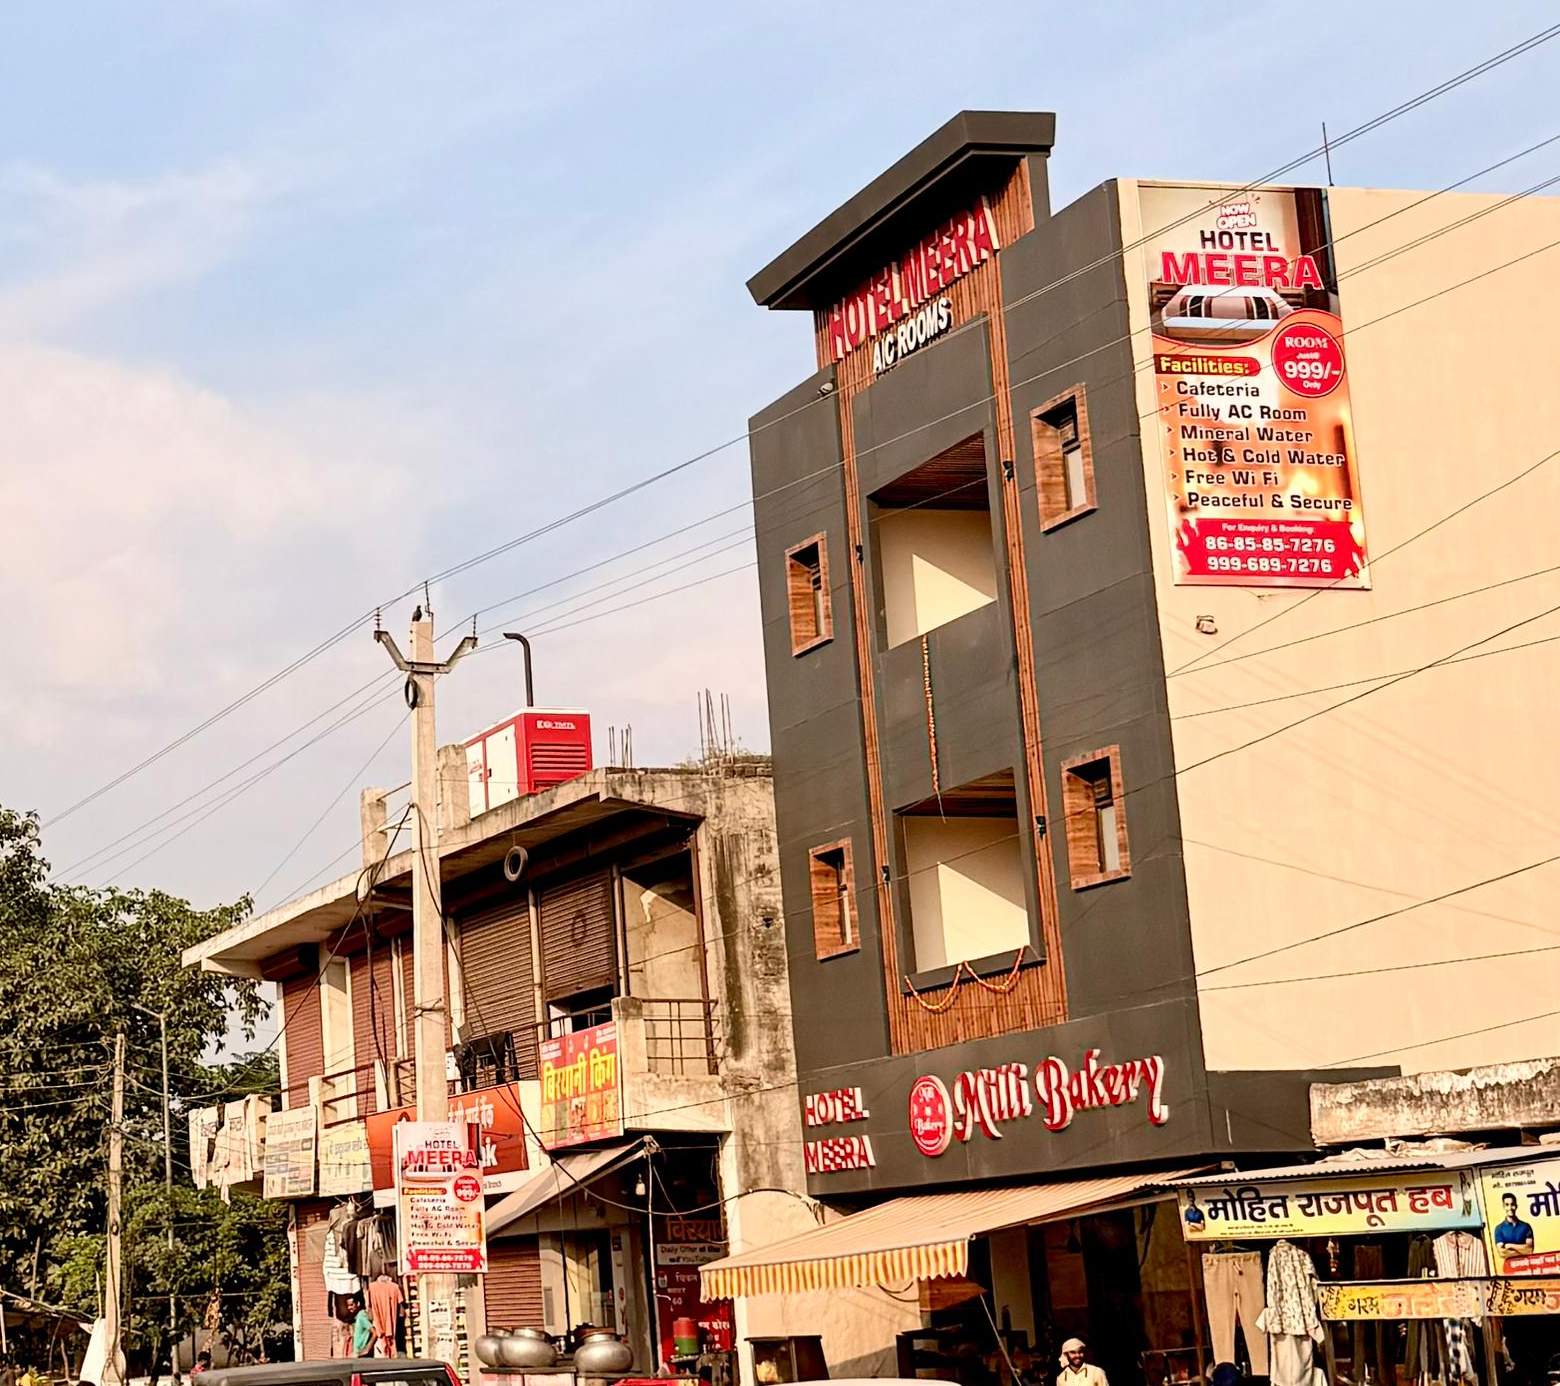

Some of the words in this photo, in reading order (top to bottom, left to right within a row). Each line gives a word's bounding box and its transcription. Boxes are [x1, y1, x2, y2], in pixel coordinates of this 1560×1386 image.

[1220, 202, 1250, 215] NOW
[1216, 213, 1256, 230] OPEN
[1199, 230, 1279, 252] HOTEL
[829, 261, 911, 363] HOTEL
[904, 196, 1000, 308] MEERA
[1161, 251, 1325, 291] MEERA
[897, 297, 953, 358] ROOMS
[1285, 336, 1328, 349] ROOM
[1160, 356, 1250, 375] Facilities:
[1284, 361, 1340, 380] 999/-
[1176, 380, 1260, 397] Cafeteria
[1303, 380, 1322, 389] Only
[1179, 403, 1221, 421] Fully
[1228, 405, 1252, 419] AC
[1260, 405, 1307, 421] Room
[1181, 425, 1250, 441] Mineral
[1256, 427, 1313, 442] Water
[1183, 447, 1217, 462] Hot
[1223, 449, 1236, 463] &
[1243, 449, 1280, 464] Cold
[1288, 450, 1345, 465] Water
[1185, 470, 1225, 484] Free
[1232, 471, 1255, 485] Wi
[1263, 472, 1279, 486] Fi
[1188, 492, 1264, 508] Peaceful
[1271, 494, 1284, 508] &
[1290, 495, 1353, 511] Secure
[1222, 523, 1237, 532] For
[1205, 535, 1336, 552] 86-85-85-7276
[1207, 556, 1333, 573] 999-689-7276
[589, 1046, 616, 1092] किंग
[1034, 1048, 1169, 1133] Bakery
[805, 1086, 870, 1127] HOTEL
[424, 1140, 460, 1150] HOTEL
[805, 1134, 876, 1174] MEERA
[407, 1150, 478, 1166] MEERA
[1205, 1186, 1289, 1224] मोहित
[1295, 1186, 1401, 1227] राजपूत
[1404, 1184, 1454, 1214] हब
[1513, 1288, 1547, 1305] गरम
